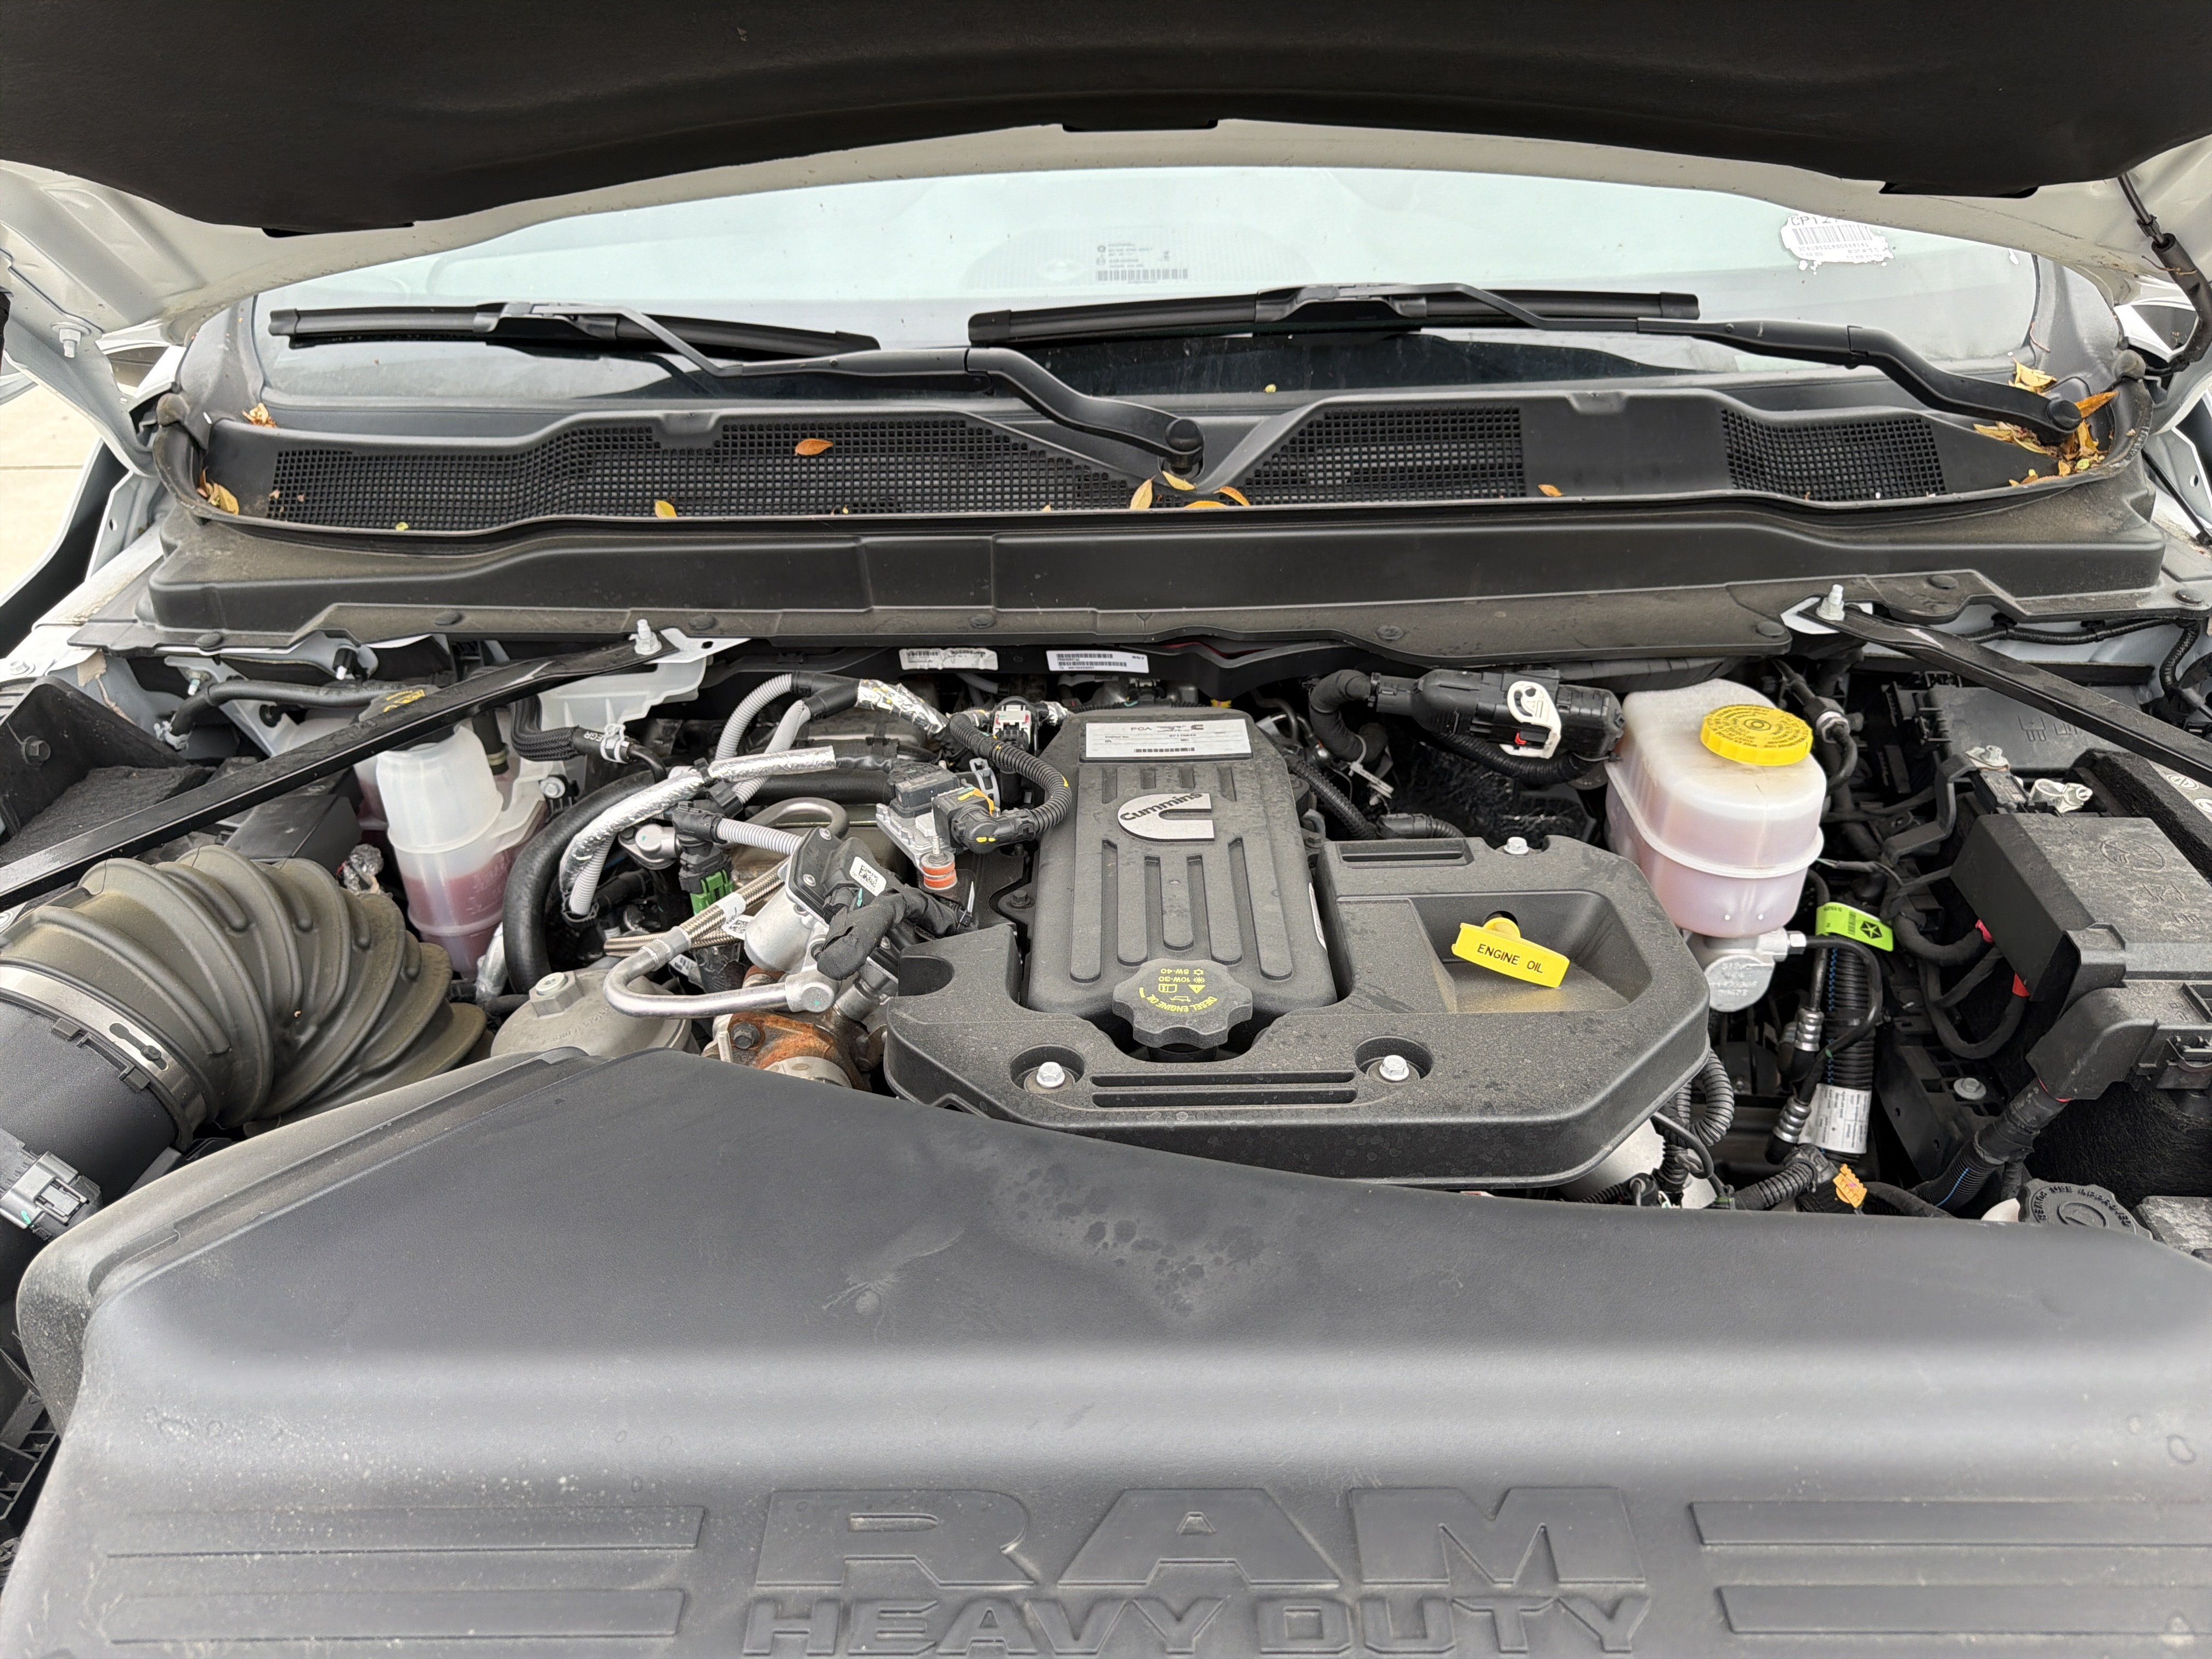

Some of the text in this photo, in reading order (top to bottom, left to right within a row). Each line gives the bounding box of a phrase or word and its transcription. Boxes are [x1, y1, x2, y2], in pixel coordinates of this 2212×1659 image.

[1120, 792, 1203, 821] Cummins
[1477, 943, 1543, 973] ENGINE OIL
[1147, 994, 1218, 1012] DIESEL ENGINE OIL
[754, 1485, 1646, 1589] RAM
[744, 1595, 1651, 1657] HEAVY DUTY
